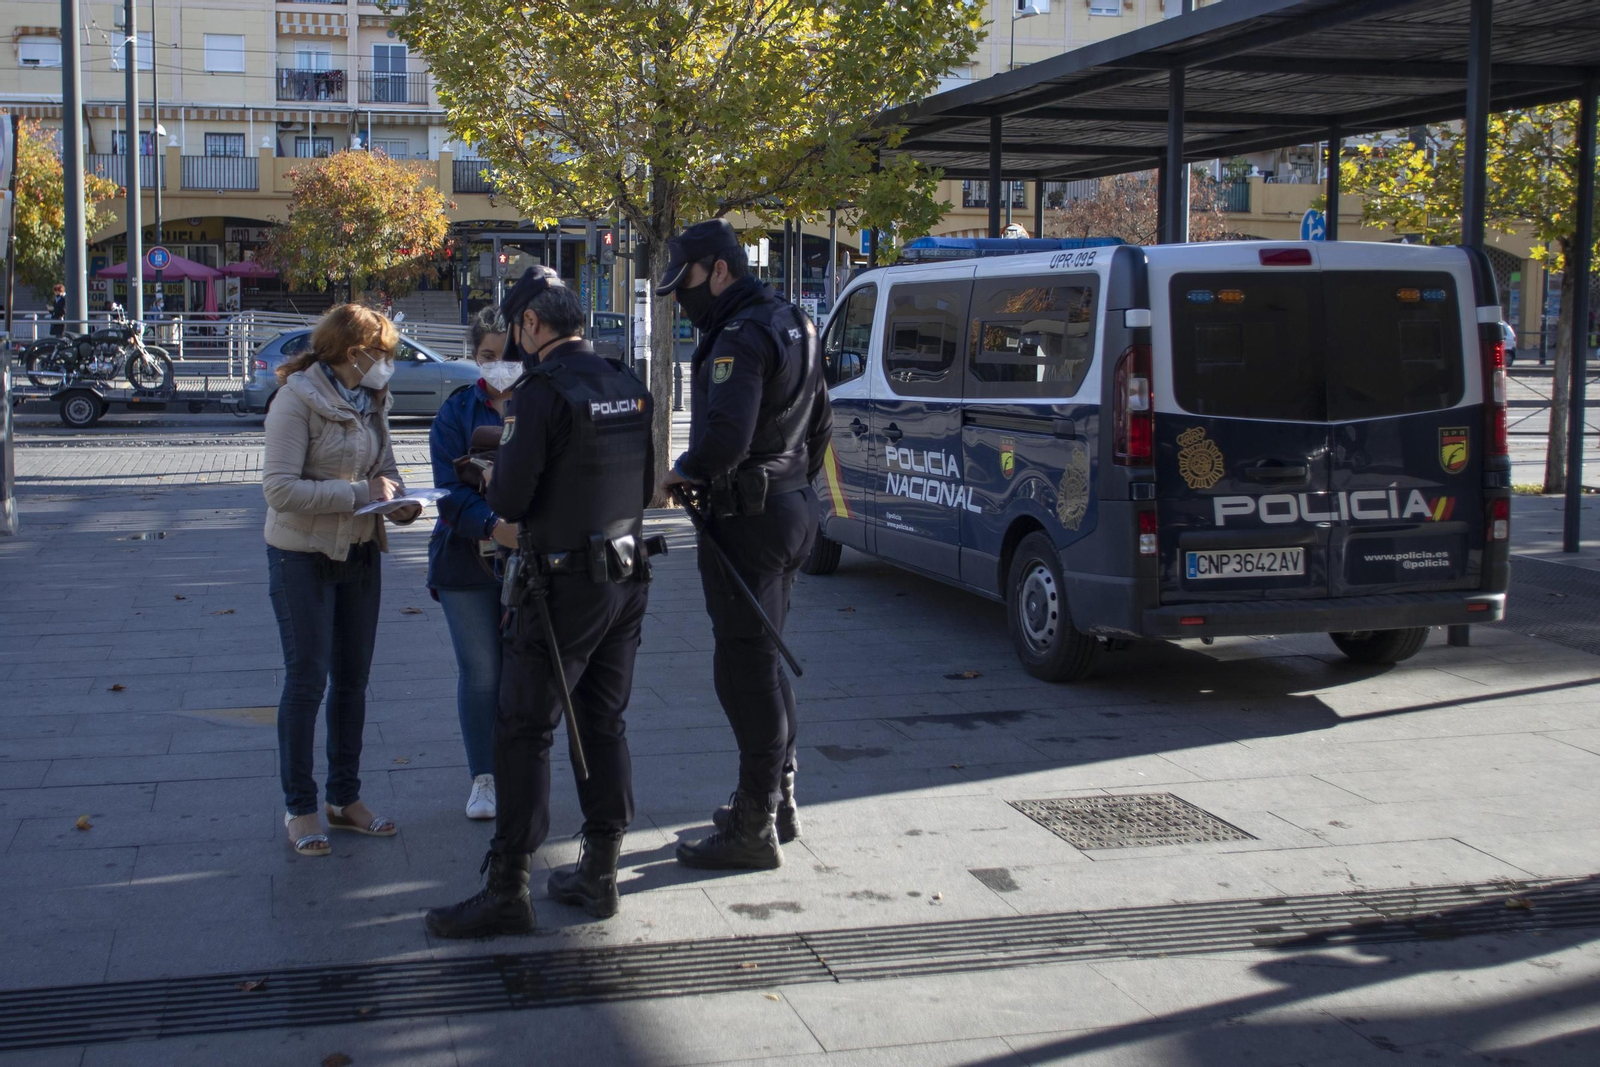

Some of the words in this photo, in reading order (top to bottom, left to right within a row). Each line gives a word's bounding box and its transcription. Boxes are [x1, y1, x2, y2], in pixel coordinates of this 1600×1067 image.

[1050, 251, 1097, 269] UPR-09B
[885, 445, 961, 479] POLICÍA
[886, 472, 982, 514] NACIONAL
[1213, 481, 1433, 526] POLICÍA
[1364, 551, 1449, 562] www.policia.es
[1402, 559, 1450, 570] @policia
